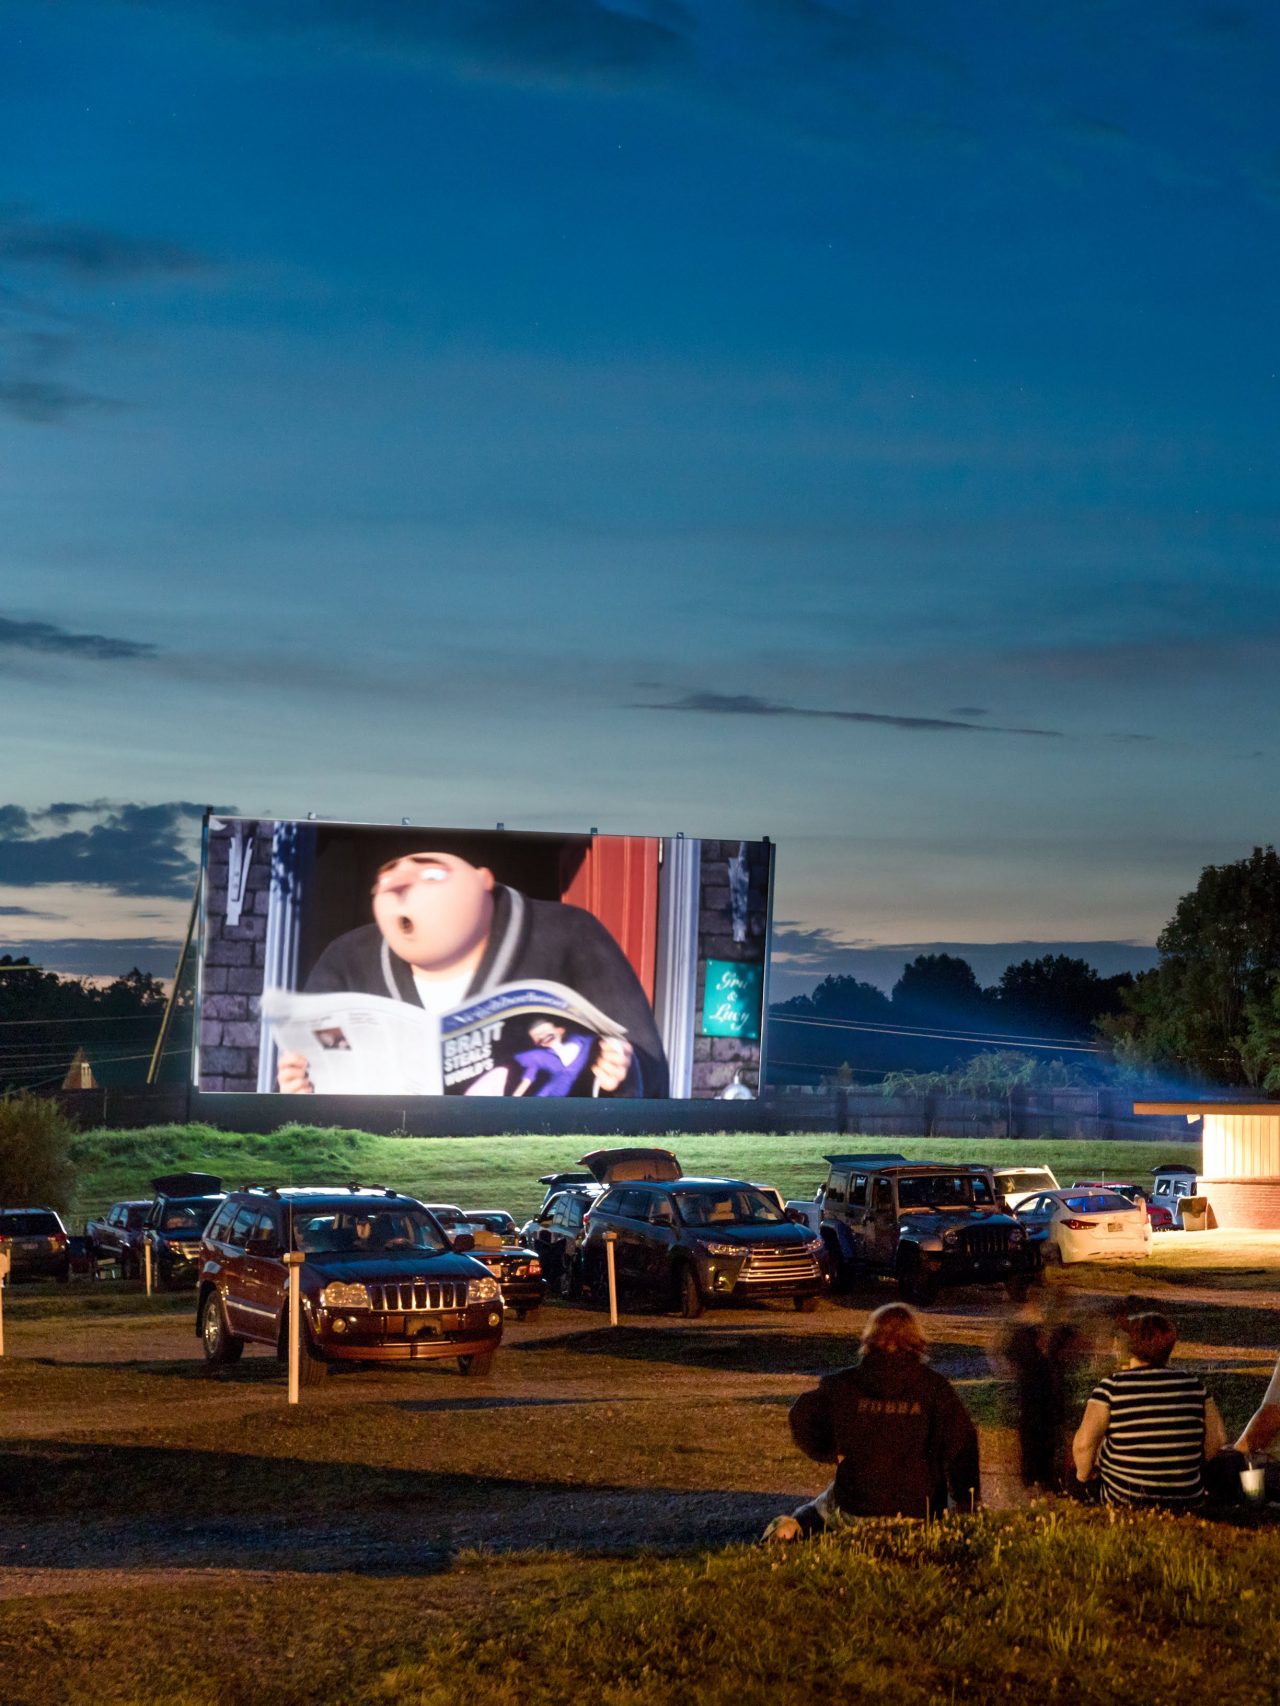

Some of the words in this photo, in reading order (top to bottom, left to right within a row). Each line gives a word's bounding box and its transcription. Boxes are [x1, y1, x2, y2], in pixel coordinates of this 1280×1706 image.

[716, 971, 748, 990] Gru
[726, 990, 738, 1002] &
[708, 1003, 750, 1031] Lucy
[445, 1021, 505, 1058] BRATT
[444, 1044, 493, 1072] STEALS
